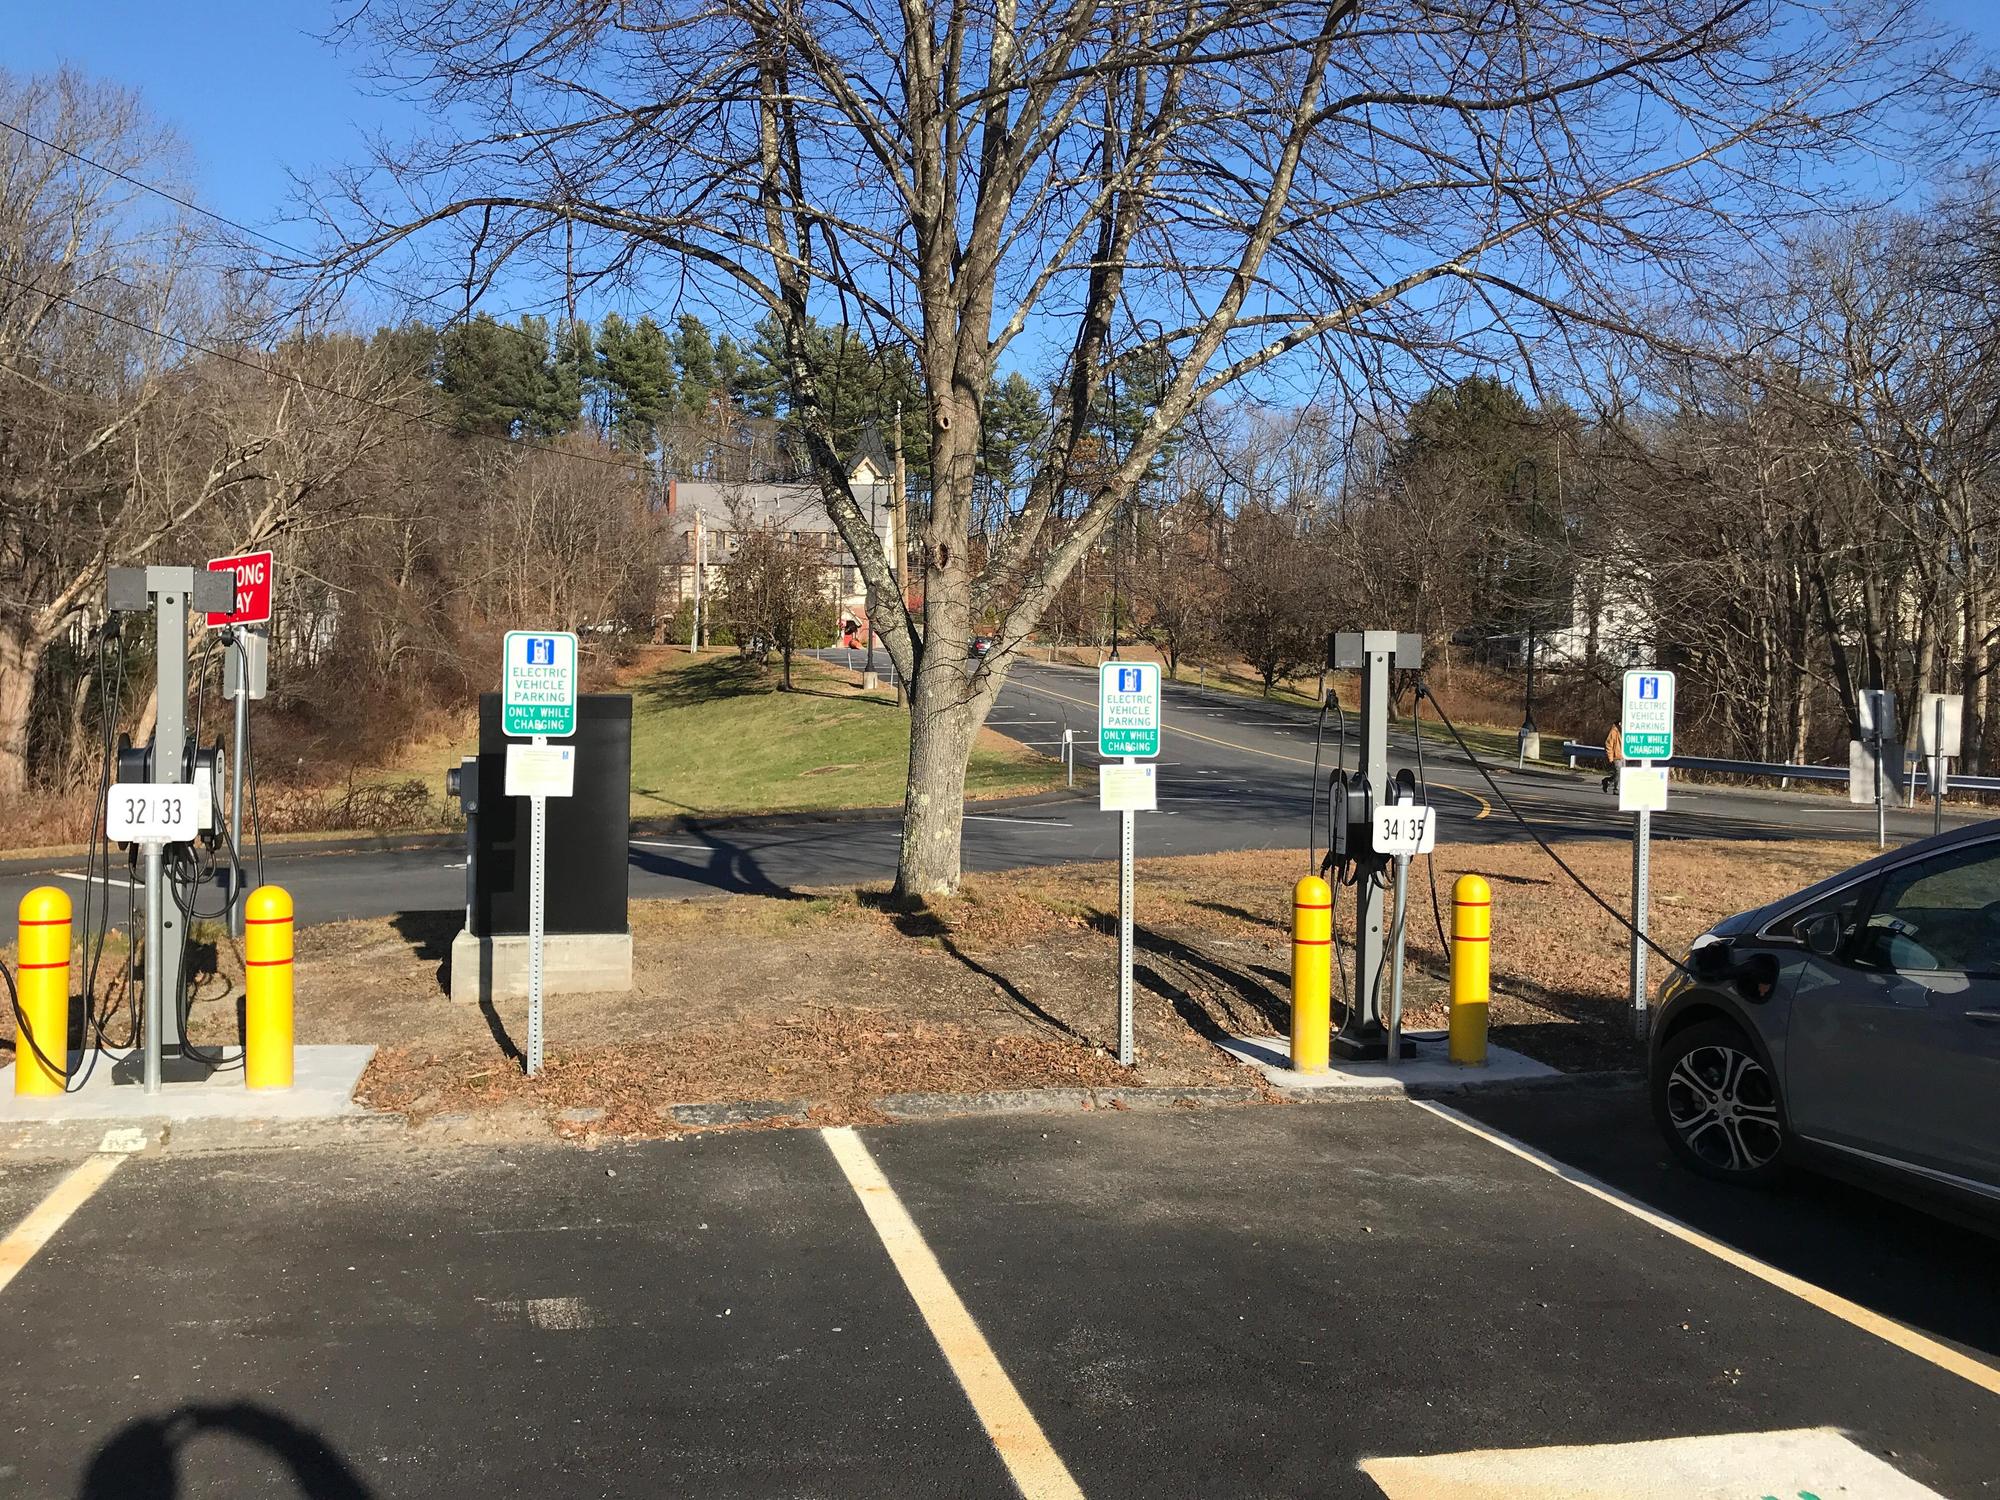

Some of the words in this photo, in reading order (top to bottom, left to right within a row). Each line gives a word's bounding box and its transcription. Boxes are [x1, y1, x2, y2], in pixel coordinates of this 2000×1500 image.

[236, 591, 253, 613] AY
[513, 667, 567, 678] ELECTRIC
[515, 680, 565, 690] VEHICLE
[514, 692, 565, 702] PARKING
[1107, 695, 1152, 704] ELECTRIC
[1109, 706, 1150, 715] VEHICLE
[1629, 701, 1667, 710] ELECTRIC
[508, 707, 535, 717] ONLY
[540, 707, 570, 718] WHILE
[1630, 712, 1665, 720] VEHICLE
[513, 720, 565, 730] CHARGING
[1108, 717, 1151, 726] PARKING
[1629, 722, 1665, 731] PARKING
[1103, 731, 1126, 740] ONLY
[1129, 731, 1155, 740] WHILE
[1625, 735, 1644, 744] ONLY
[1647, 735, 1669, 744] WHILE
[1108, 742, 1150, 752] CHARGING
[1629, 745, 1665, 755] CHARGING
[125, 798, 146, 824] 32
[161, 798, 182, 824] 33
[1383, 819, 1399, 840] 34
[1409, 819, 1425, 840] 35
